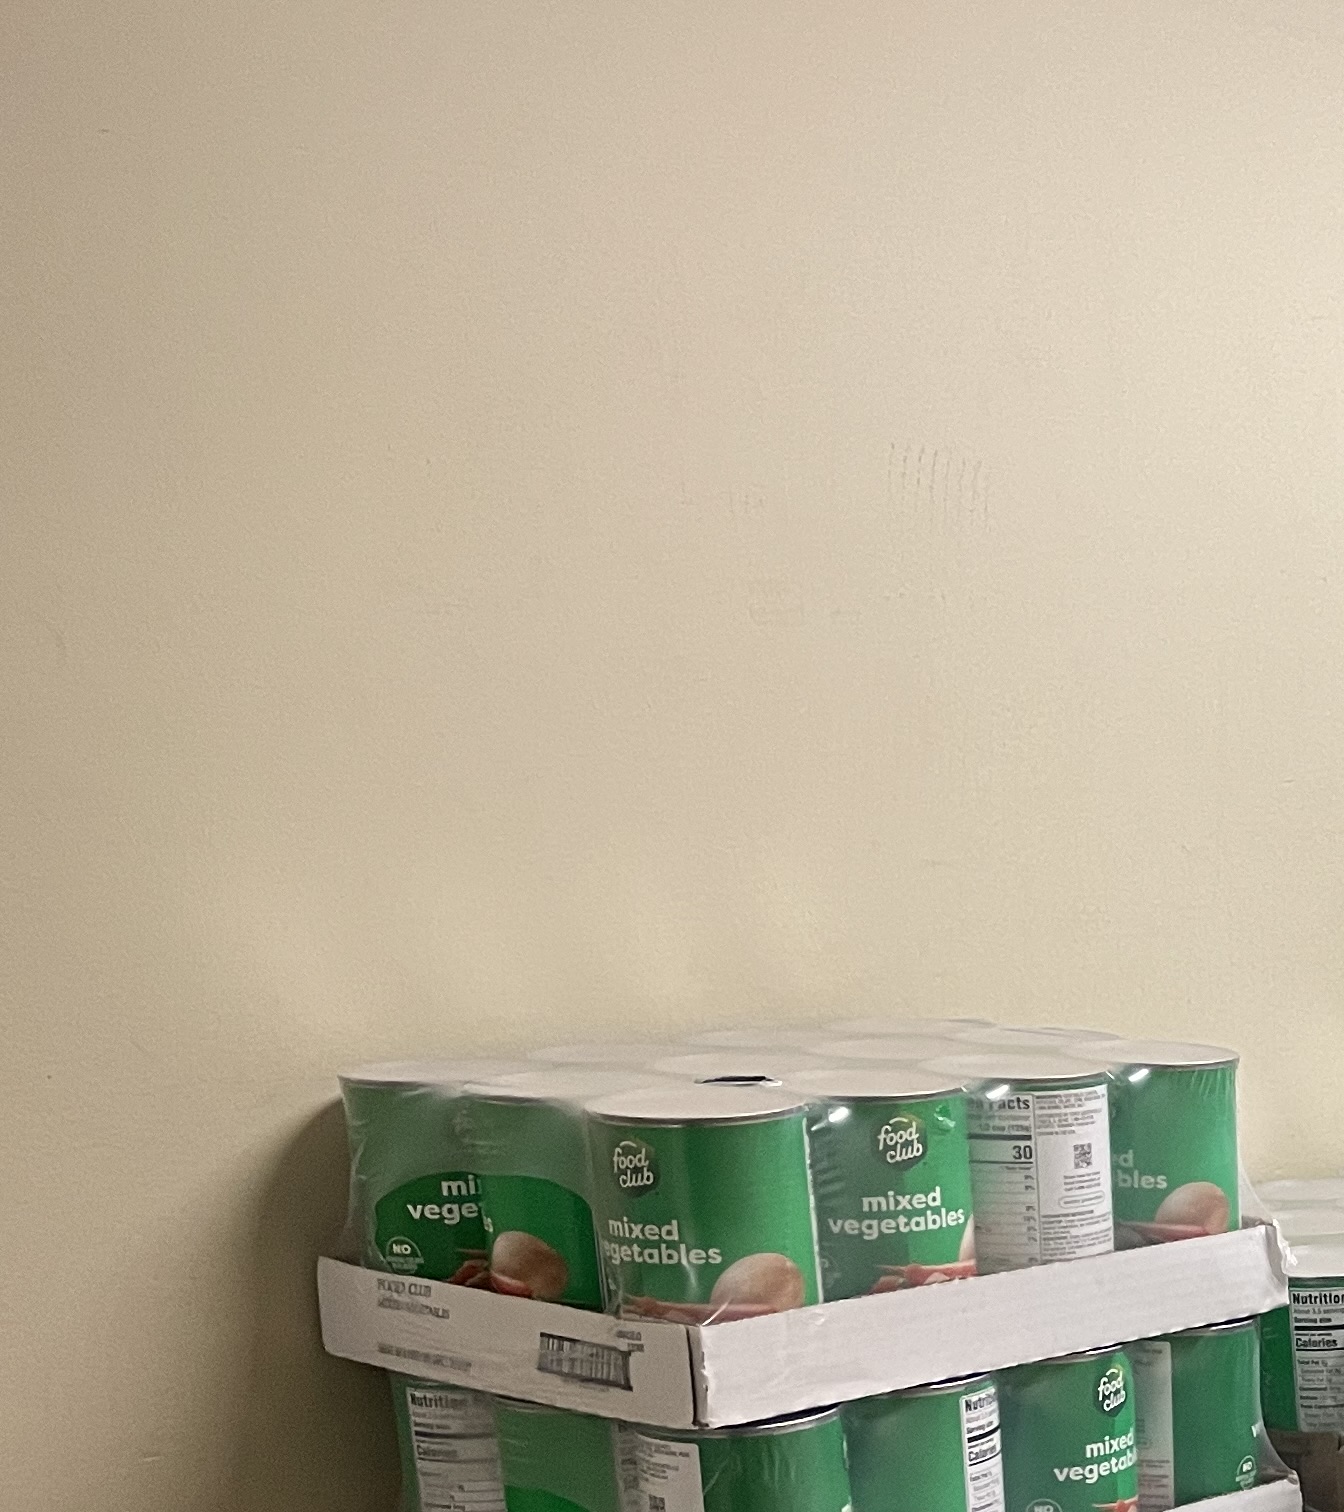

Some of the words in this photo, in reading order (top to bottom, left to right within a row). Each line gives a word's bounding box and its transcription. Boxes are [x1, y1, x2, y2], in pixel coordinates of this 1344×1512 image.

[878, 1125, 919, 1151] food
[613, 1148, 647, 1172] food
[886, 1141, 923, 1164] club
[1012, 1145, 1033, 1161] 30
[619, 1169, 655, 1188] club
[862, 1187, 942, 1211] mixed
[608, 1218, 679, 1240] mixed
[827, 1207, 965, 1240] vegetables
[393, 1243, 411, 1255] NO
[602, 1243, 722, 1266] egetables
[1296, 1338, 1337, 1347] Calories
[1098, 1370, 1123, 1401] food
[1104, 1391, 1125, 1413] club
[1086, 1427, 1134, 1458] mixed
[1054, 1450, 1137, 1484] vegetab
